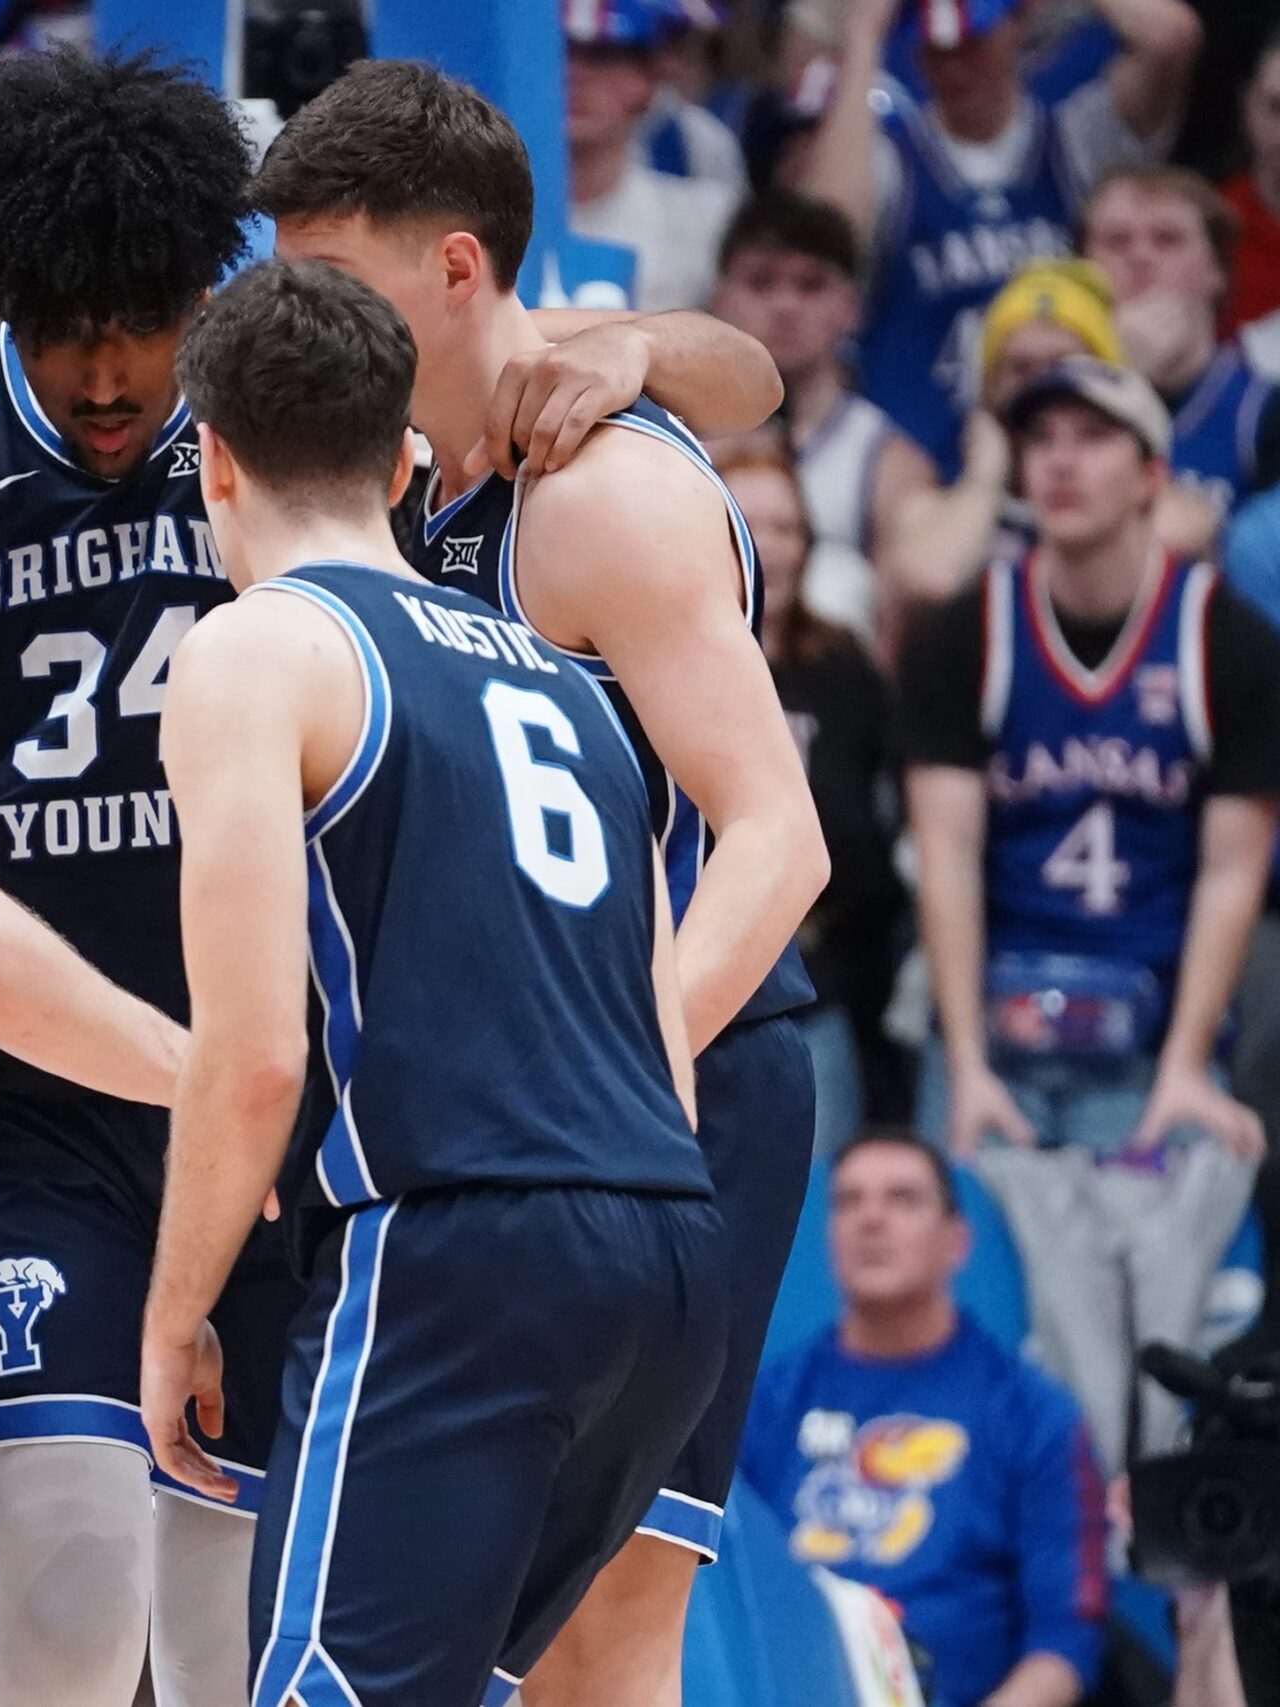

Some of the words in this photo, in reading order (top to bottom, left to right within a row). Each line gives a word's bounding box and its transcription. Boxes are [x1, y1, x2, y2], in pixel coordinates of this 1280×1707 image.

[11, 604, 198, 781] 34
[392, 591, 560, 675] KOSTIC
[479, 677, 612, 912] 6
[1040, 799, 1132, 917] 4
